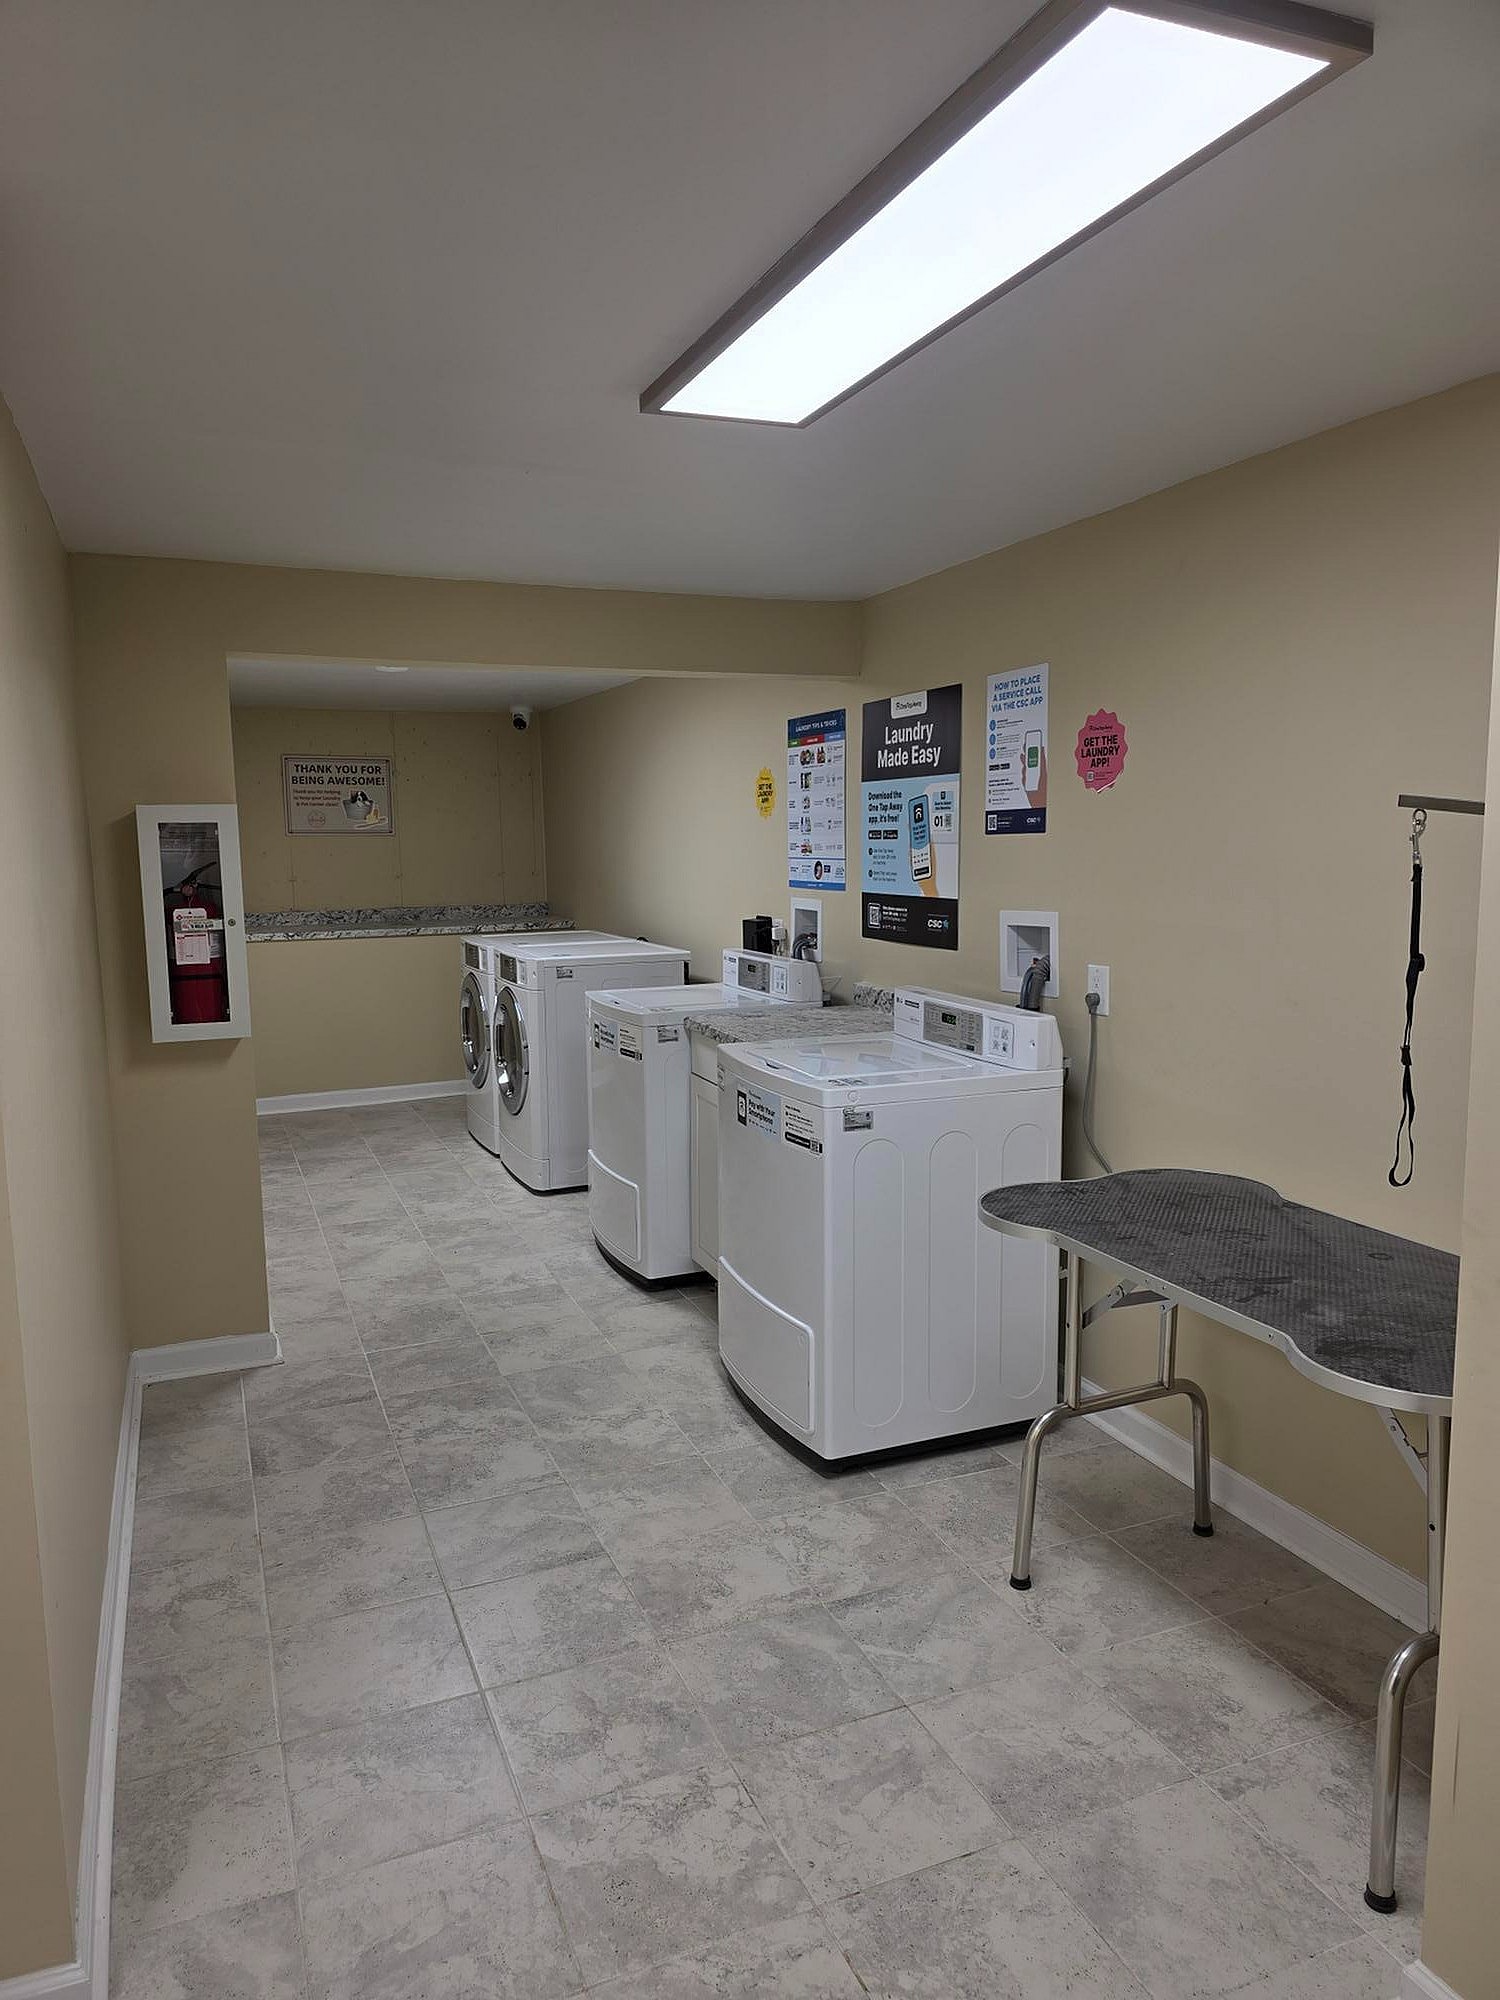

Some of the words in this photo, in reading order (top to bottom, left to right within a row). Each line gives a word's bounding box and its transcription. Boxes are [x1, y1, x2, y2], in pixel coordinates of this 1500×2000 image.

[994, 681, 1010, 691] HOW
[1011, 679, 1019, 688] TO
[1020, 674, 1041, 685] PLACE
[999, 689, 1024, 701] SERVICE
[1025, 686, 1042, 695] CALL
[991, 703, 1002, 713] VIA
[1004, 701, 1015, 710] THE
[1016, 699, 1029, 708] CSC
[1030, 696, 1043, 705] APP
[885, 721, 934, 745] Laundry
[1084, 737, 1100, 747] GET
[1101, 734, 1118, 745] THE
[877, 747, 908, 768] Made
[911, 745, 941, 767] Easy
[1081, 745, 1120, 759] LAUNDRY
[1090, 757, 1110, 768] APP!
[294, 764, 332, 774] THANK
[335, 765, 358, 774] YOU
[361, 765, 382, 775] FOR
[291, 775, 324, 785] BEING
[327, 776, 386, 786] AWESOME!
[868, 791, 893, 801] Download
[893, 791, 902, 799] the
[868, 804, 879, 812] One
[879, 803, 889, 812] Tap
[889, 803, 903, 812] Away
[888, 814, 900, 823] free!
[933, 815, 944, 827] 01
[927, 919, 943, 928] CSC
